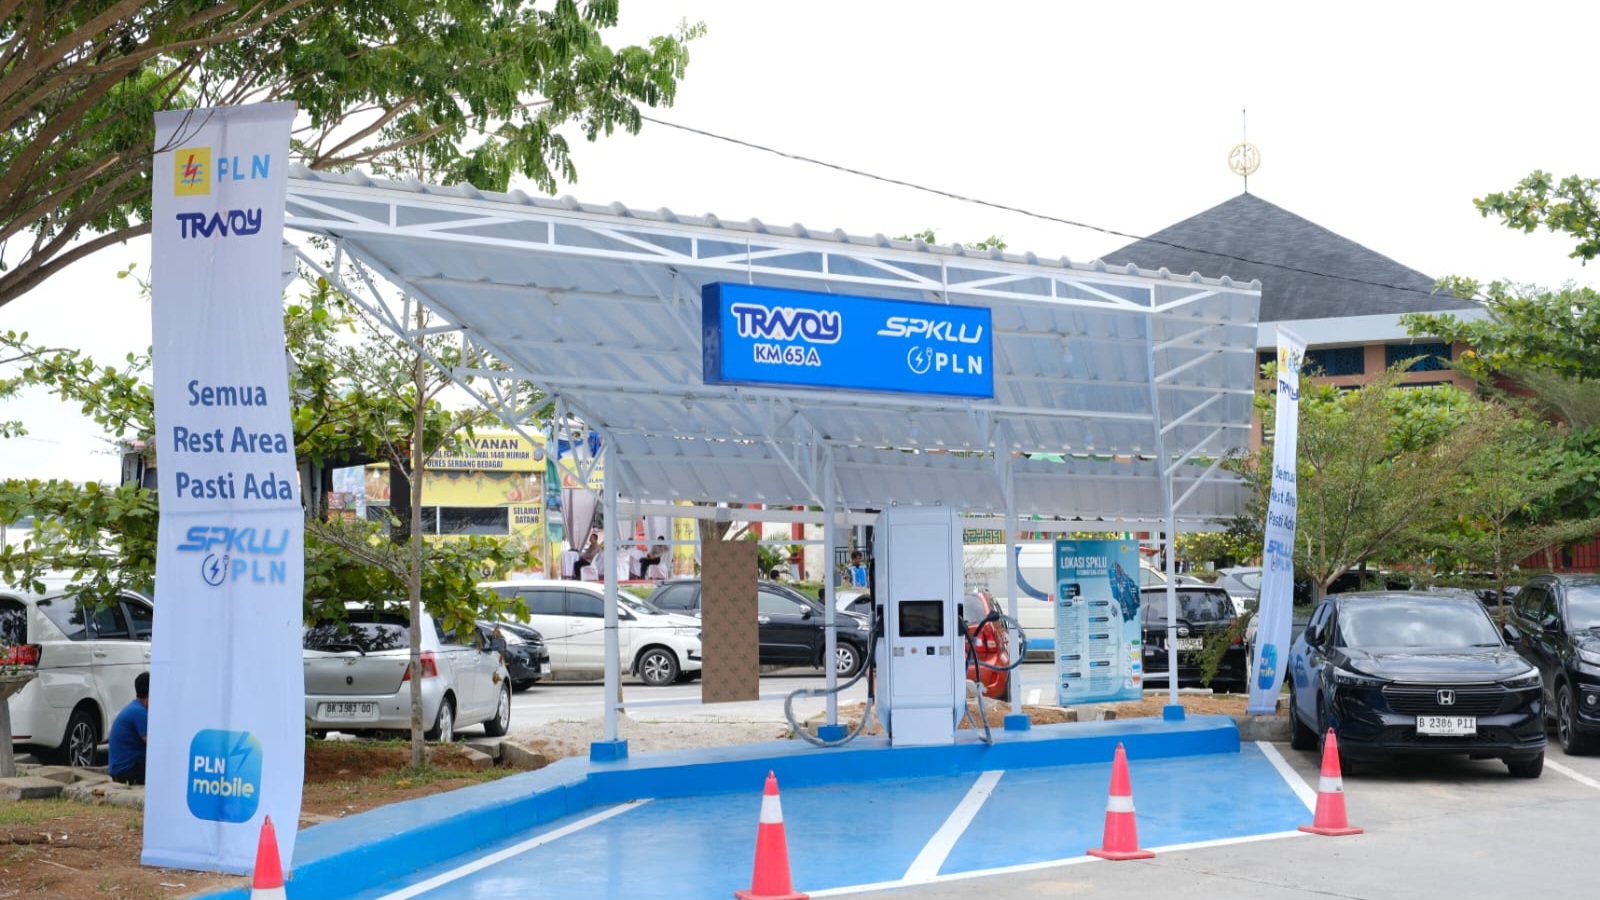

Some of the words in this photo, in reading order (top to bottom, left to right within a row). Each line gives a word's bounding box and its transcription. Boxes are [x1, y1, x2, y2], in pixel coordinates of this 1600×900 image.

[217, 154, 270, 183] PLN
[175, 208, 262, 239] TRAVOY
[731, 302, 842, 344] TRAVOY
[877, 316, 983, 344] SPKLU
[754, 343, 781, 363] KM
[783, 345, 805, 365] 65
[806, 346, 822, 366] A
[935, 352, 983, 375] PLN
[188, 380, 267, 406] Semua
[173, 426, 225, 453] Rest
[230, 426, 288, 454] Area
[175, 472, 235, 499] Pasti
[243, 472, 293, 500] Ada
[513, 507, 540, 515] SELAMAT
[1269, 511, 1284, 529] Pasti
[176, 526, 289, 554] SPKLU
[232, 559, 286, 584] PLN
[1060, 555, 1085, 569] LOKASI
[1085, 554, 1107, 569] SPKLU
[1419, 717, 1425, 728] B
[1429, 717, 1453, 728] 2386
[194, 755, 226, 774] PLN
[193, 776, 255, 798] mobile
